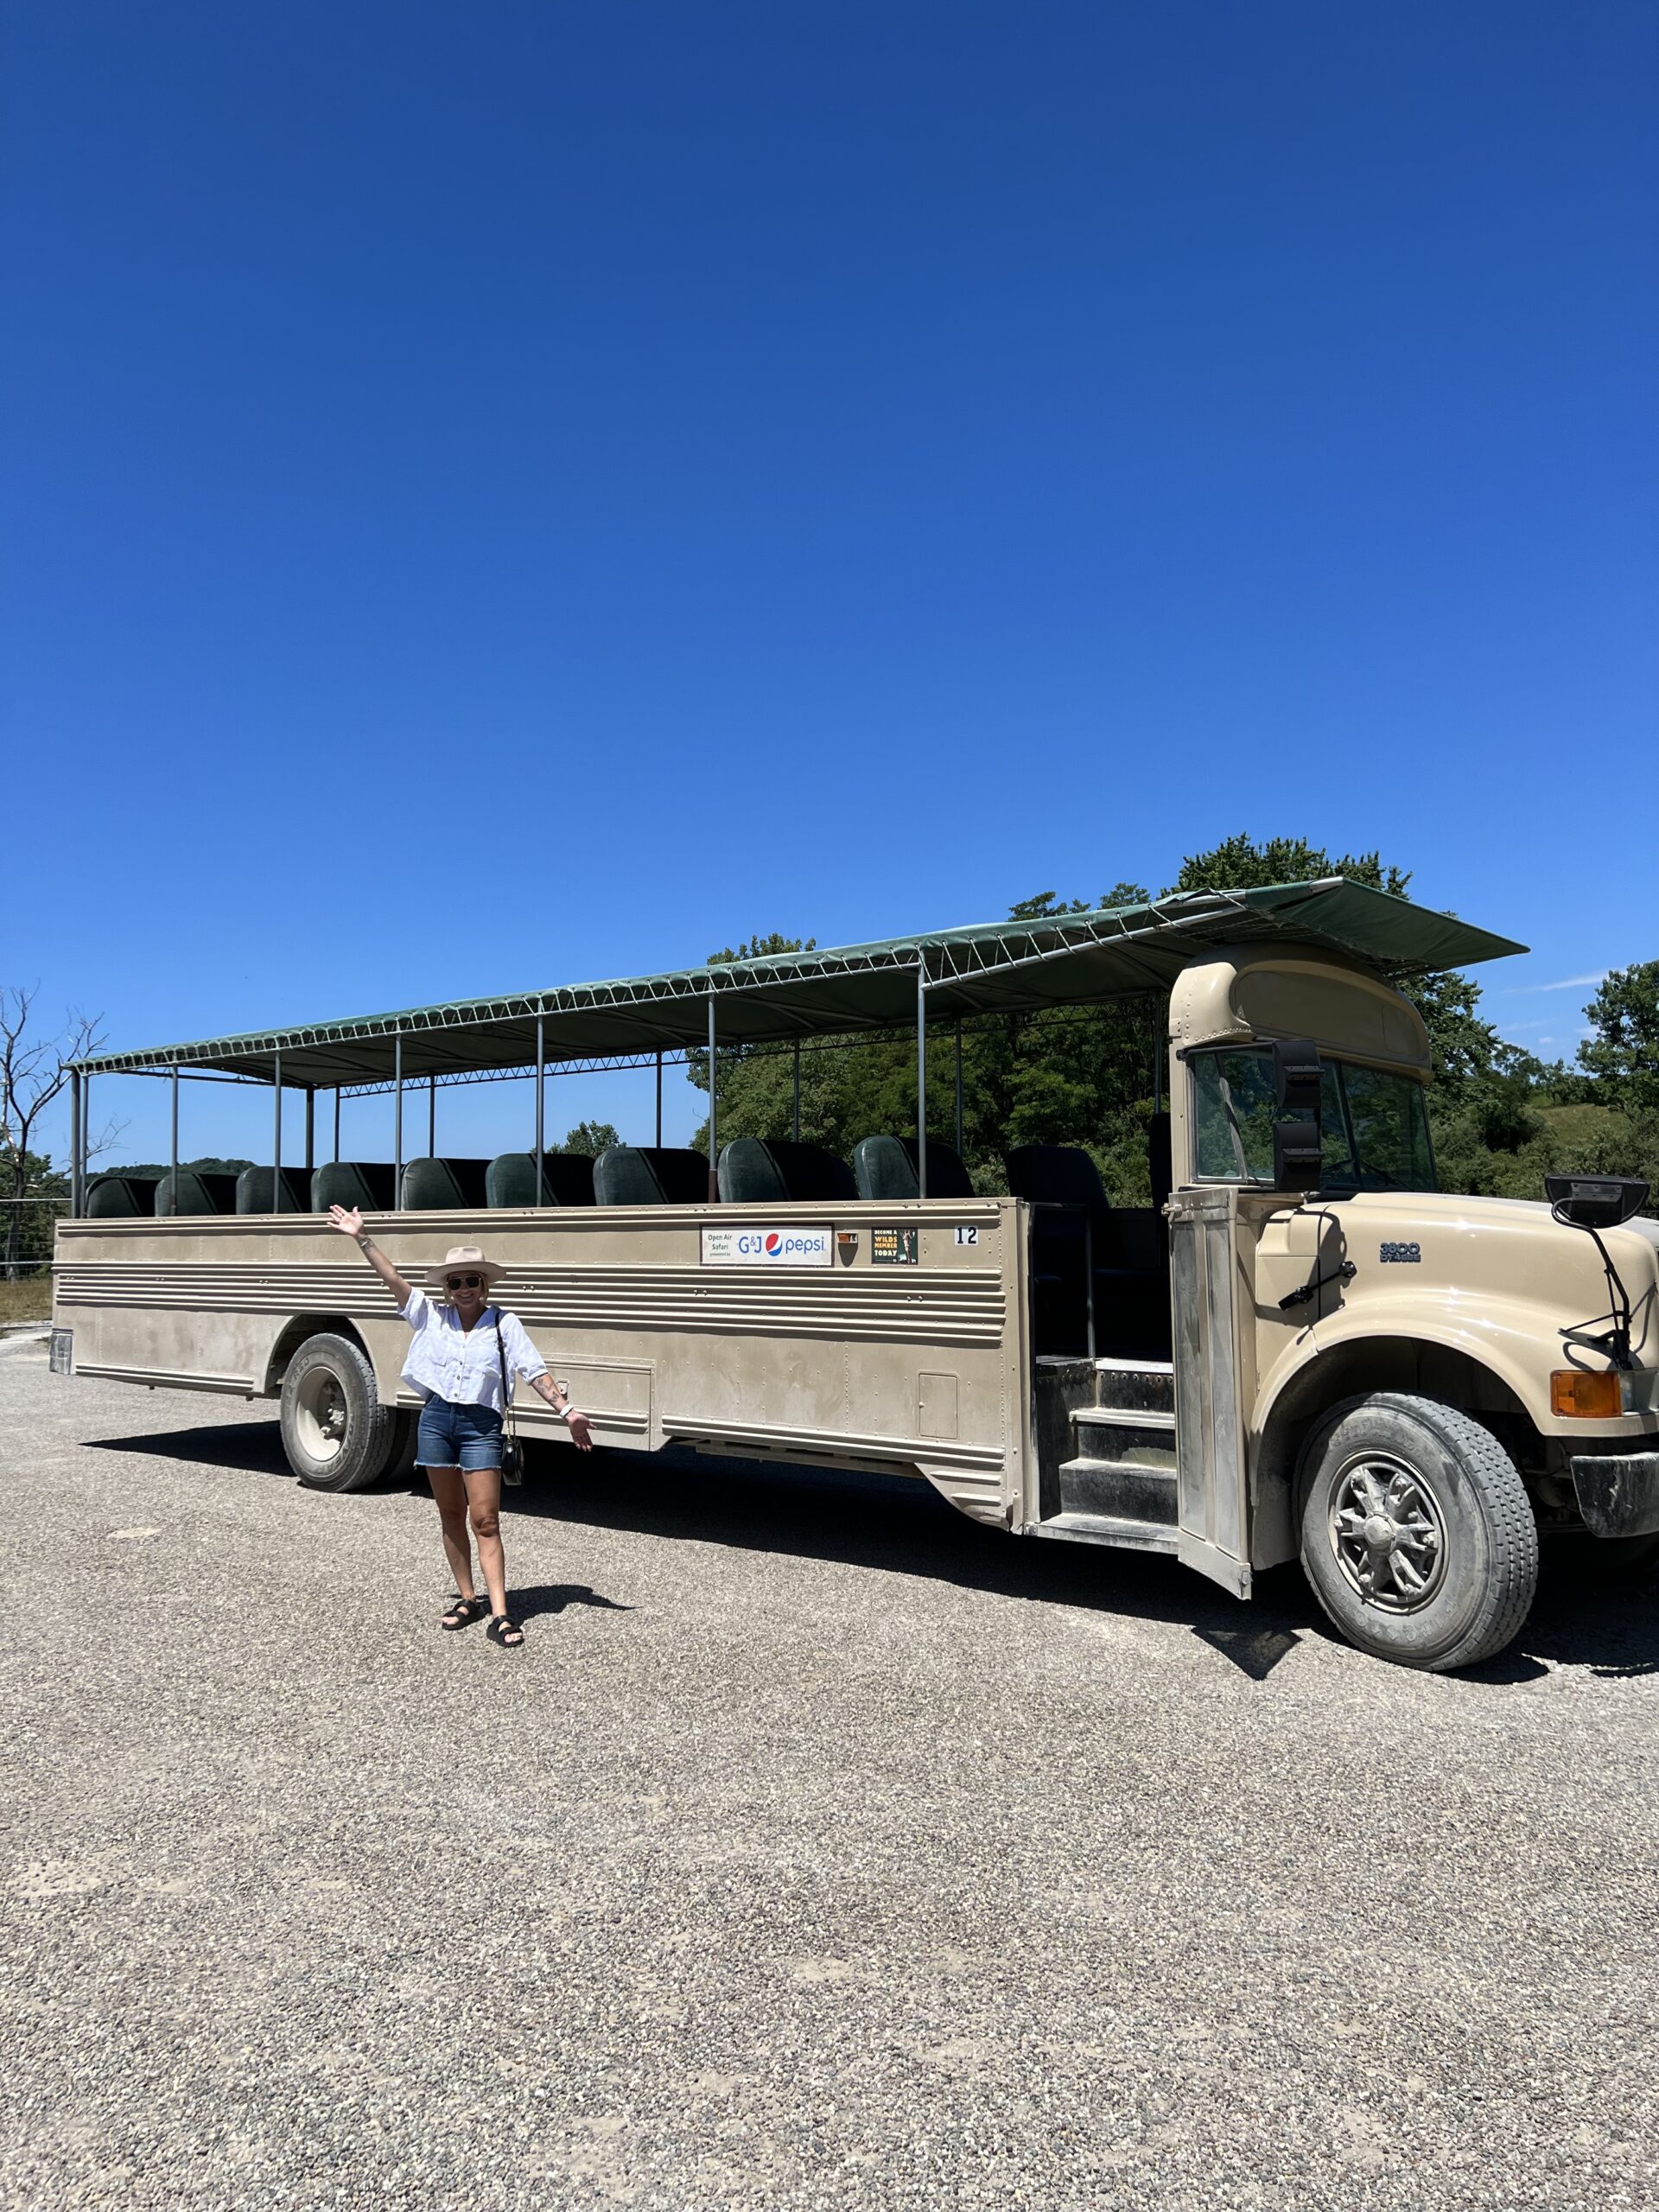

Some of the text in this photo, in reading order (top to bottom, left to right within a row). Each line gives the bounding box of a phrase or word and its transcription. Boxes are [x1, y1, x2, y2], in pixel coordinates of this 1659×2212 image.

[957, 1226, 977, 1244] 12
[738, 1236, 824, 1255] G&J pepsi
[1380, 1243, 1421, 1254] 3800
